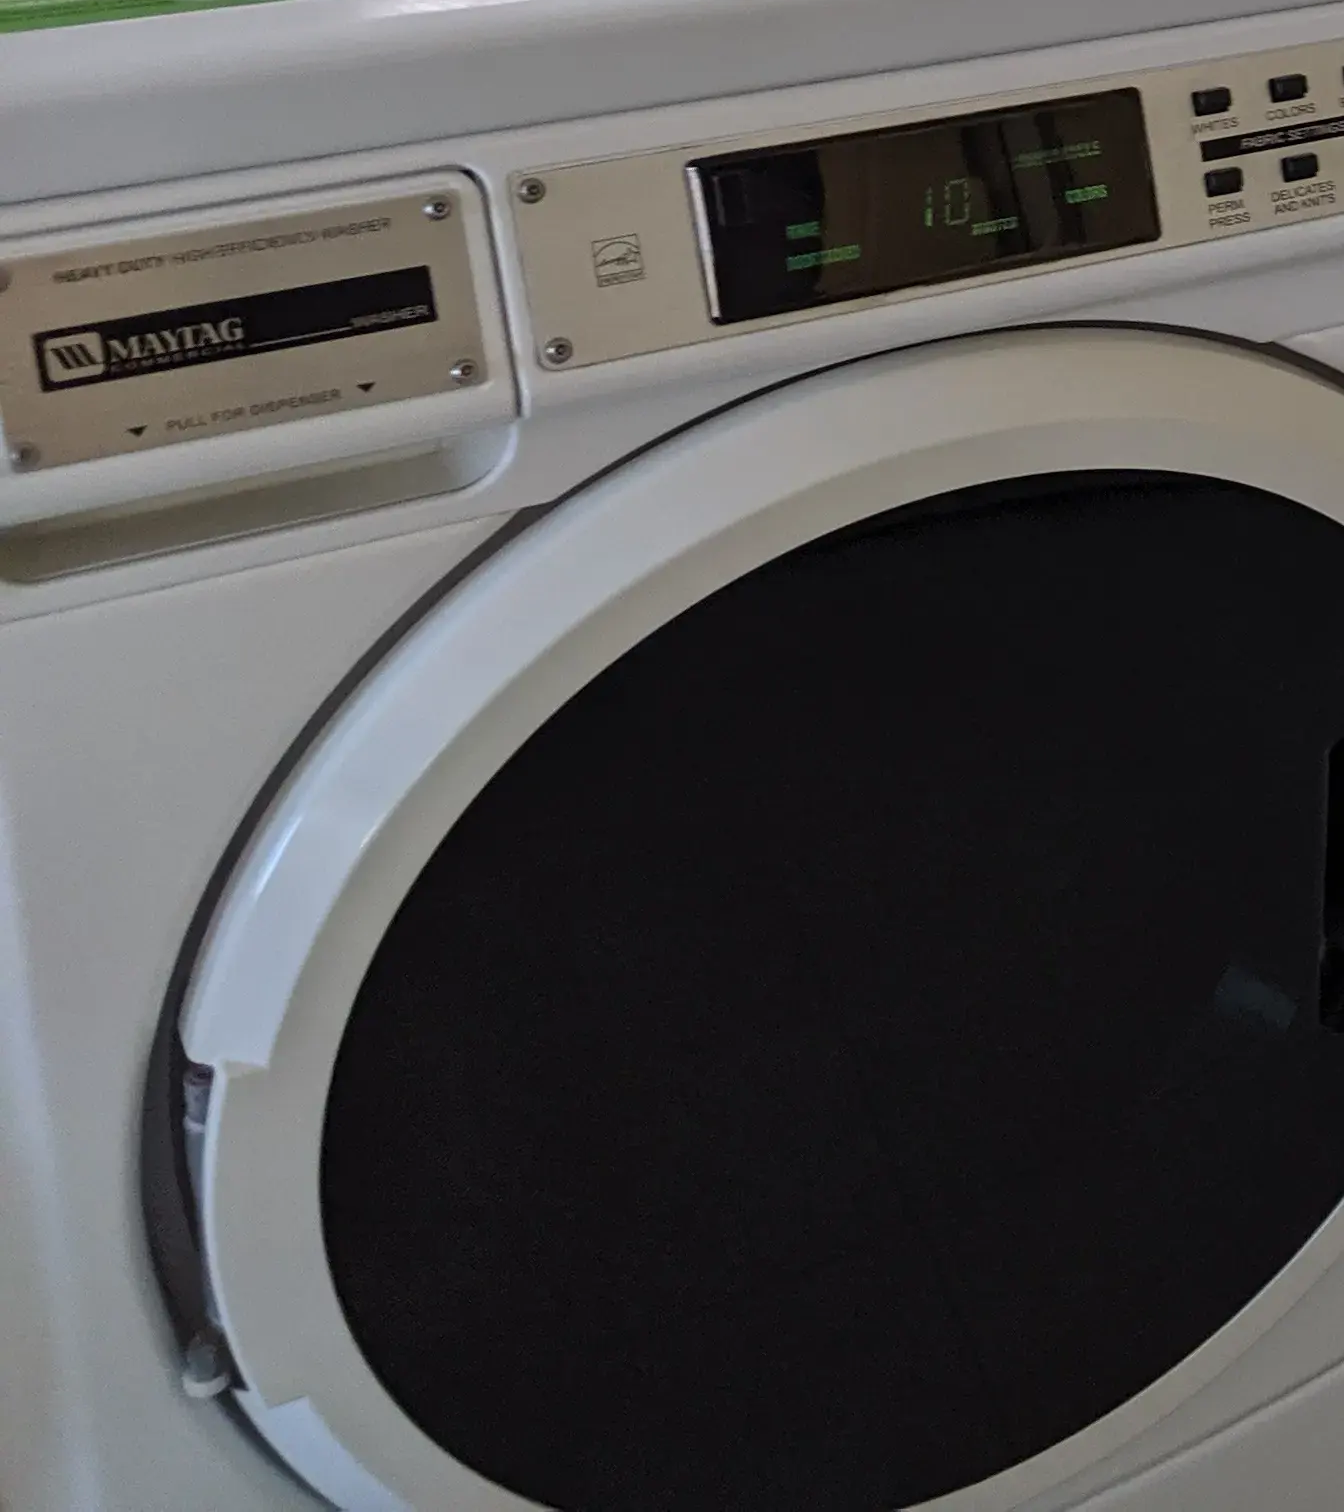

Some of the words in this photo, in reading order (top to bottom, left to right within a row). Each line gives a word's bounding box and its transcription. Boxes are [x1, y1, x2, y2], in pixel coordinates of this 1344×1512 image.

[1265, 103, 1316, 122] COLORS
[1191, 116, 1240, 135] WHITES
[1240, 132, 1285, 150] FABRIC
[924, 177, 971, 227] 10
[1270, 181, 1336, 203] DELICATES
[1208, 199, 1246, 215] PERM
[1274, 198, 1300, 216] AND
[1301, 193, 1337, 210] KNITS
[1208, 212, 1251, 229] PRESS
[52, 262, 113, 284] HEAVY
[117, 256, 166, 275] DUTY
[321, 217, 392, 240] WASHER
[350, 304, 430, 328] WASHER
[107, 317, 245, 363] MAYTAG
[165, 414, 207, 431] PULL
[210, 405, 245, 422] FOR
[249, 388, 342, 416] DISPENSER
